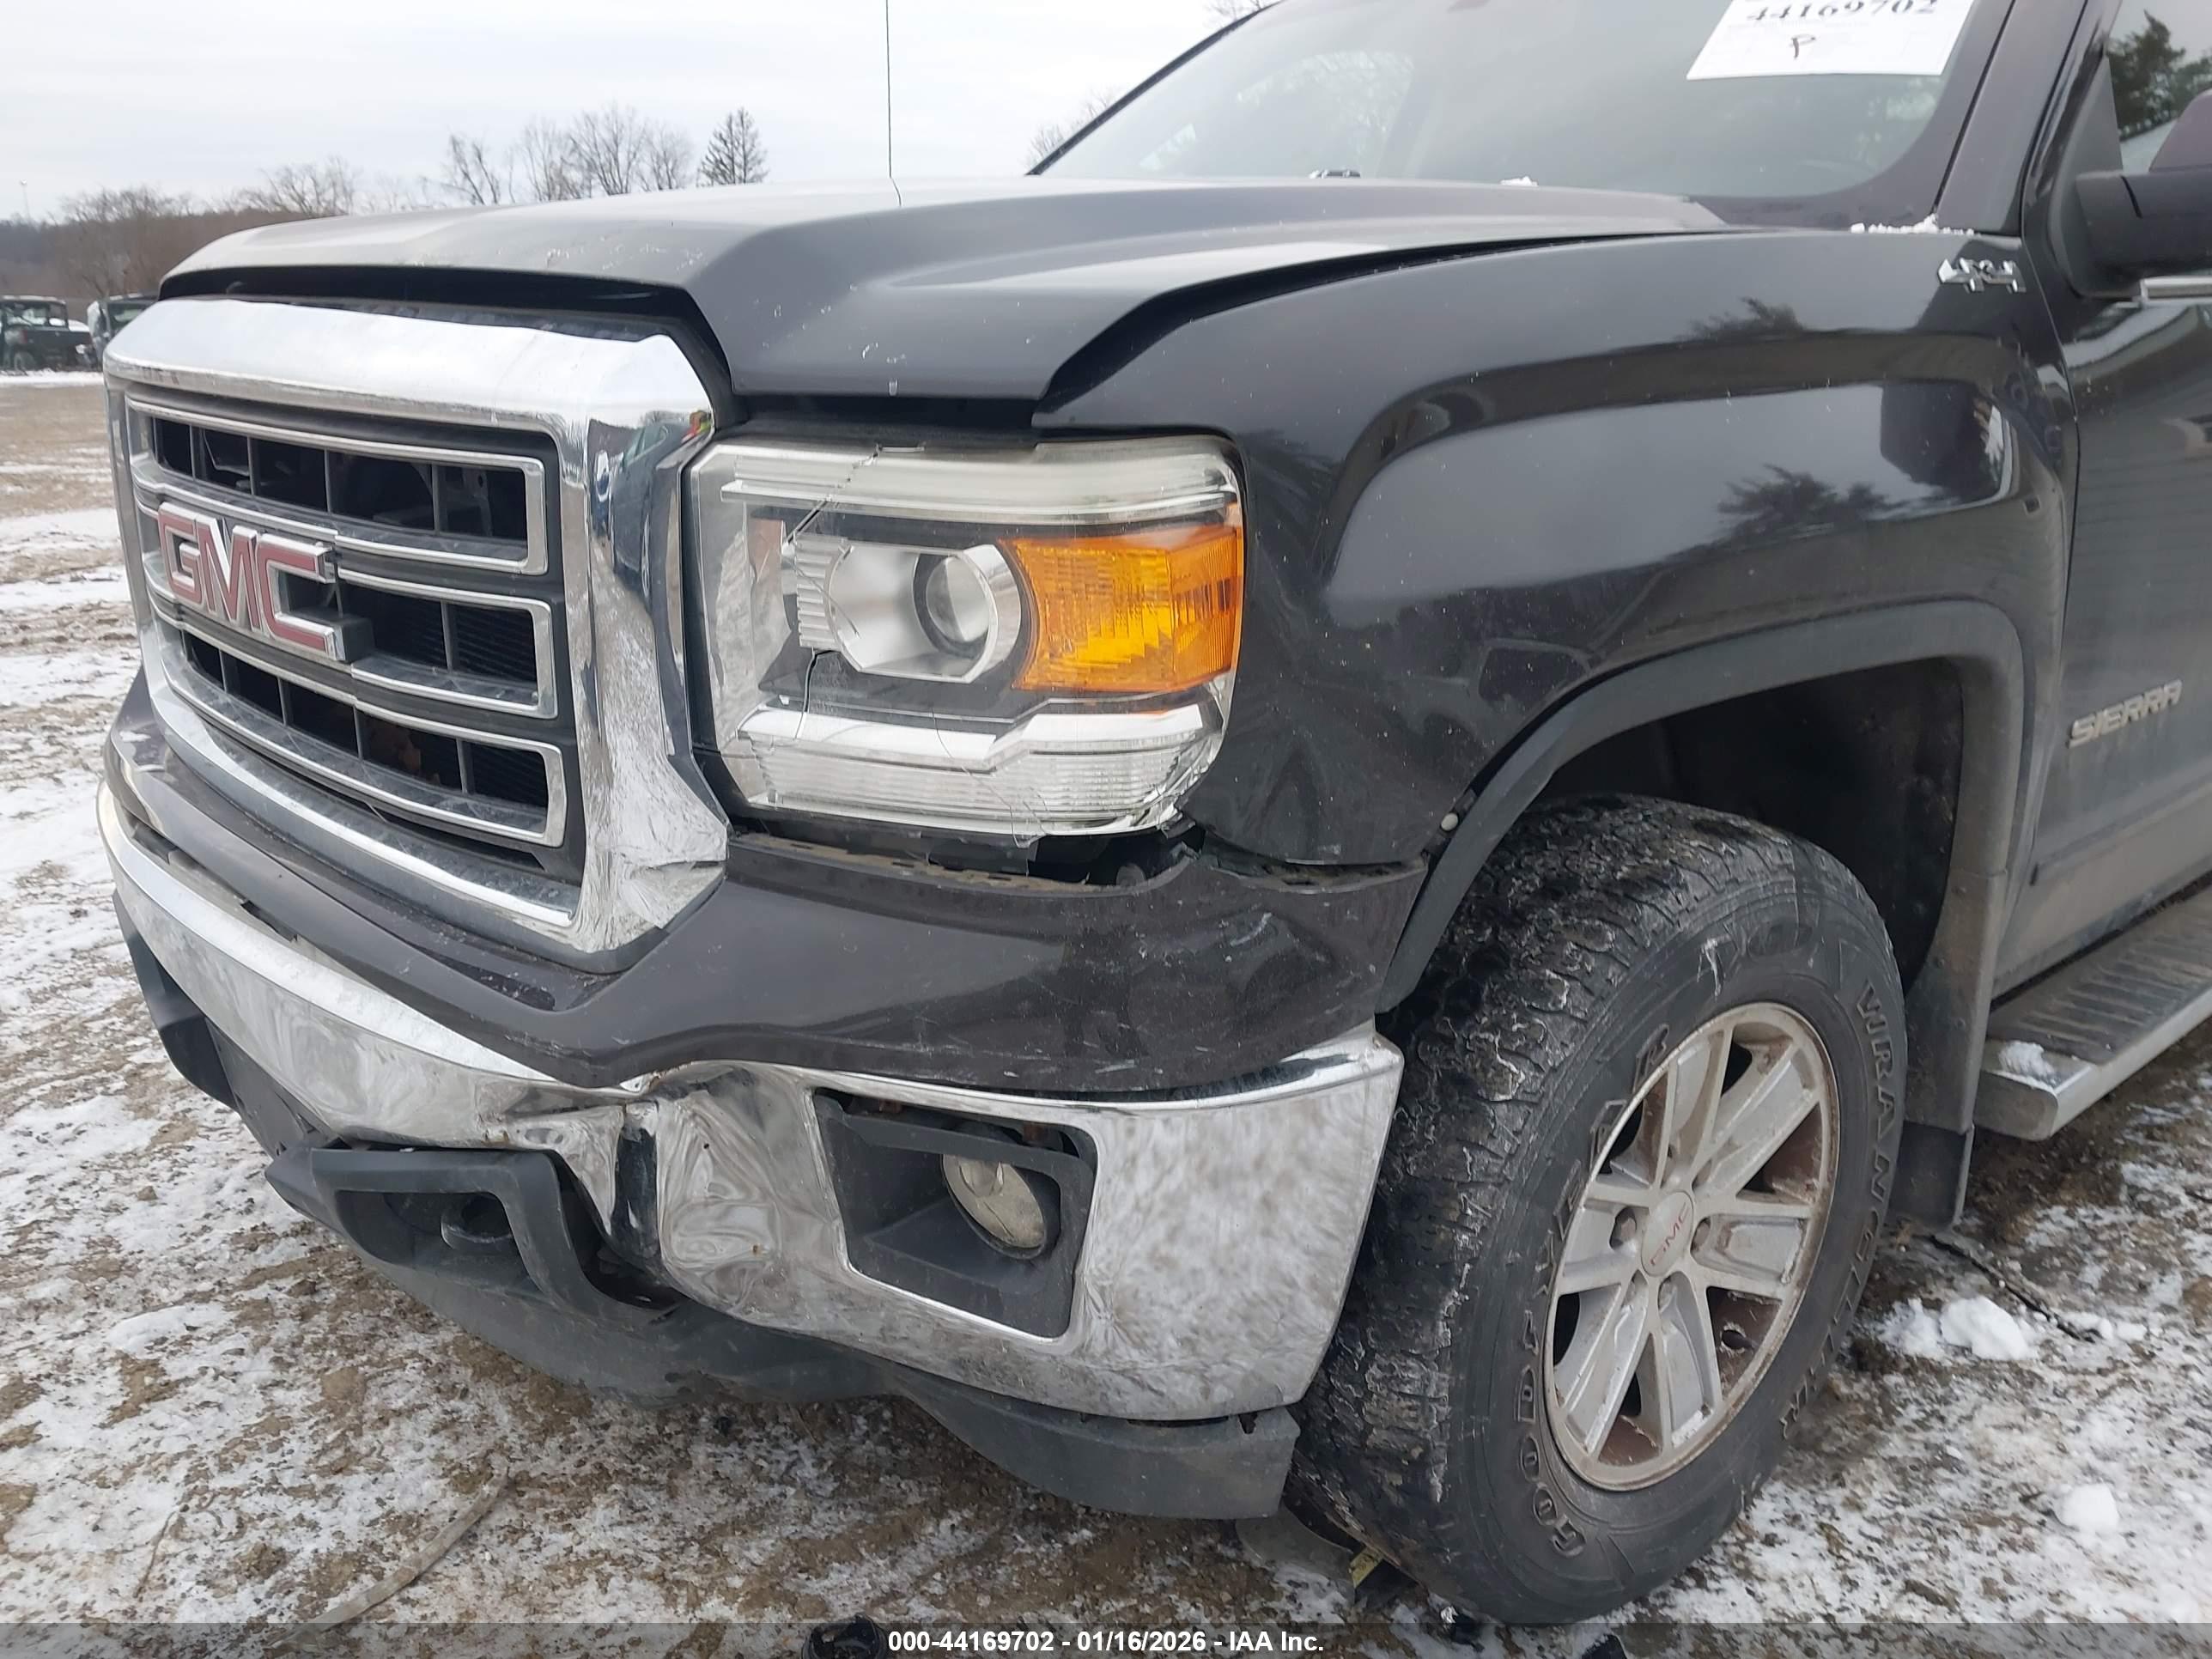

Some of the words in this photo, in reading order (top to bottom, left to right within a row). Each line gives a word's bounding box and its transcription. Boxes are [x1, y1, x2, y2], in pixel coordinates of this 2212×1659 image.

[157, 501, 345, 661] GMC
[2068, 678, 2183, 750] SIERRA
[1649, 1201, 1690, 1267] GMC
